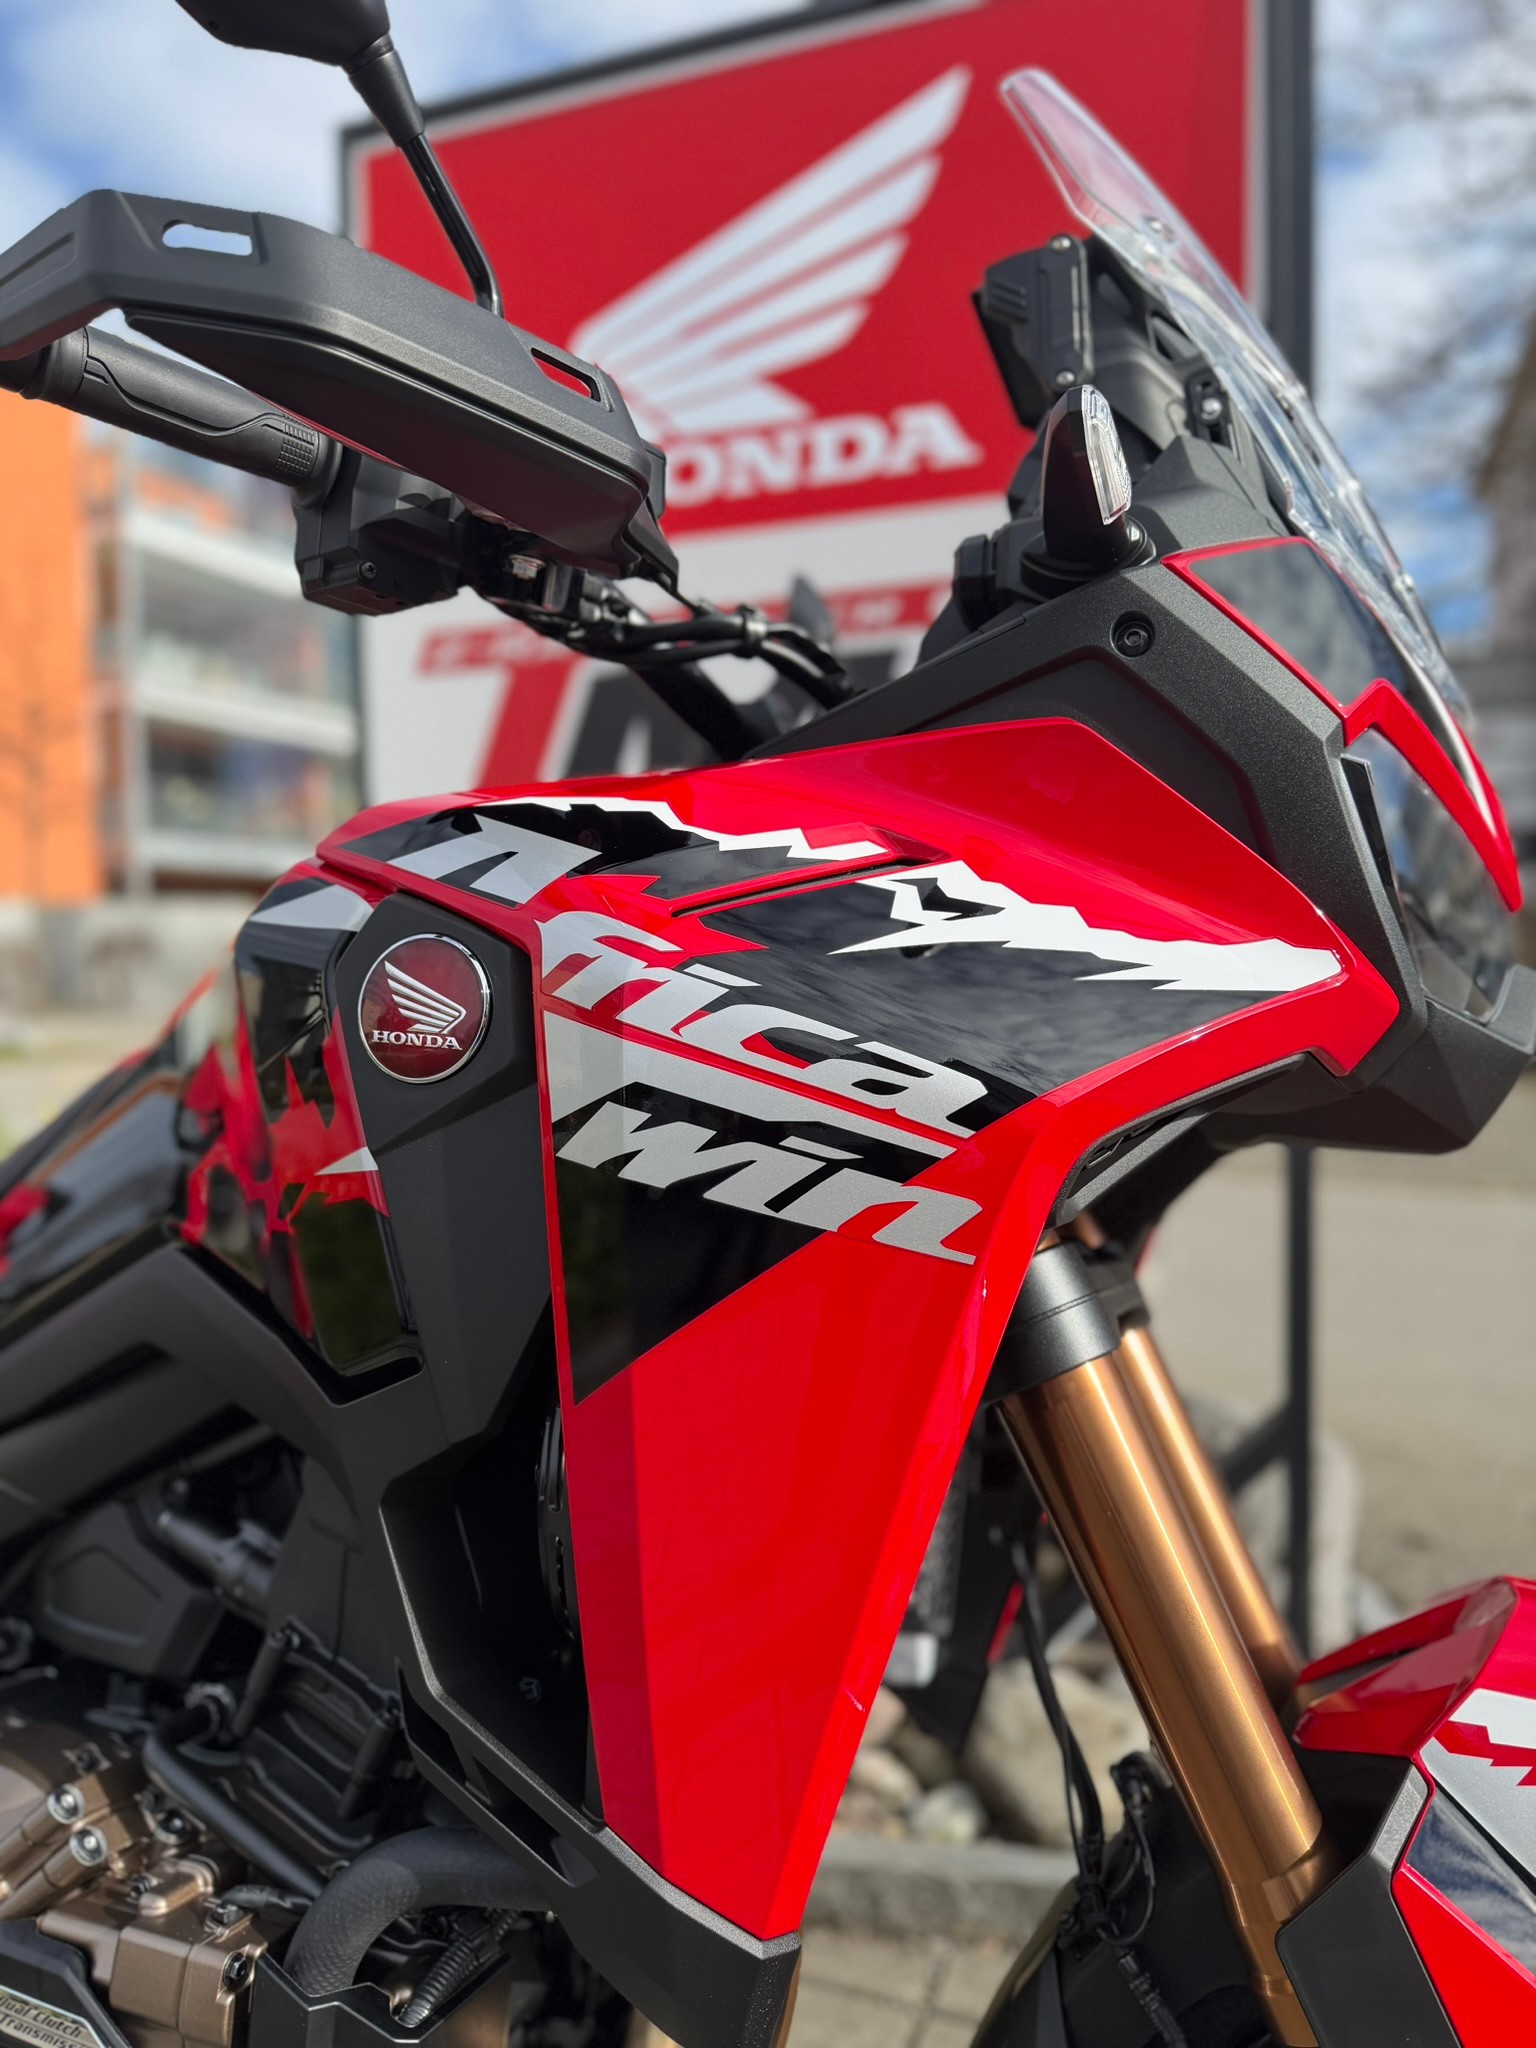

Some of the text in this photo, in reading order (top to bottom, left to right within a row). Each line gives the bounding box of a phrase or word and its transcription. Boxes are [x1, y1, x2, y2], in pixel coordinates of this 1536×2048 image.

[665, 403, 983, 507] ONDA
[371, 1029, 463, 1051] HONDA
[32, 2010, 82, 2038] Clutch
